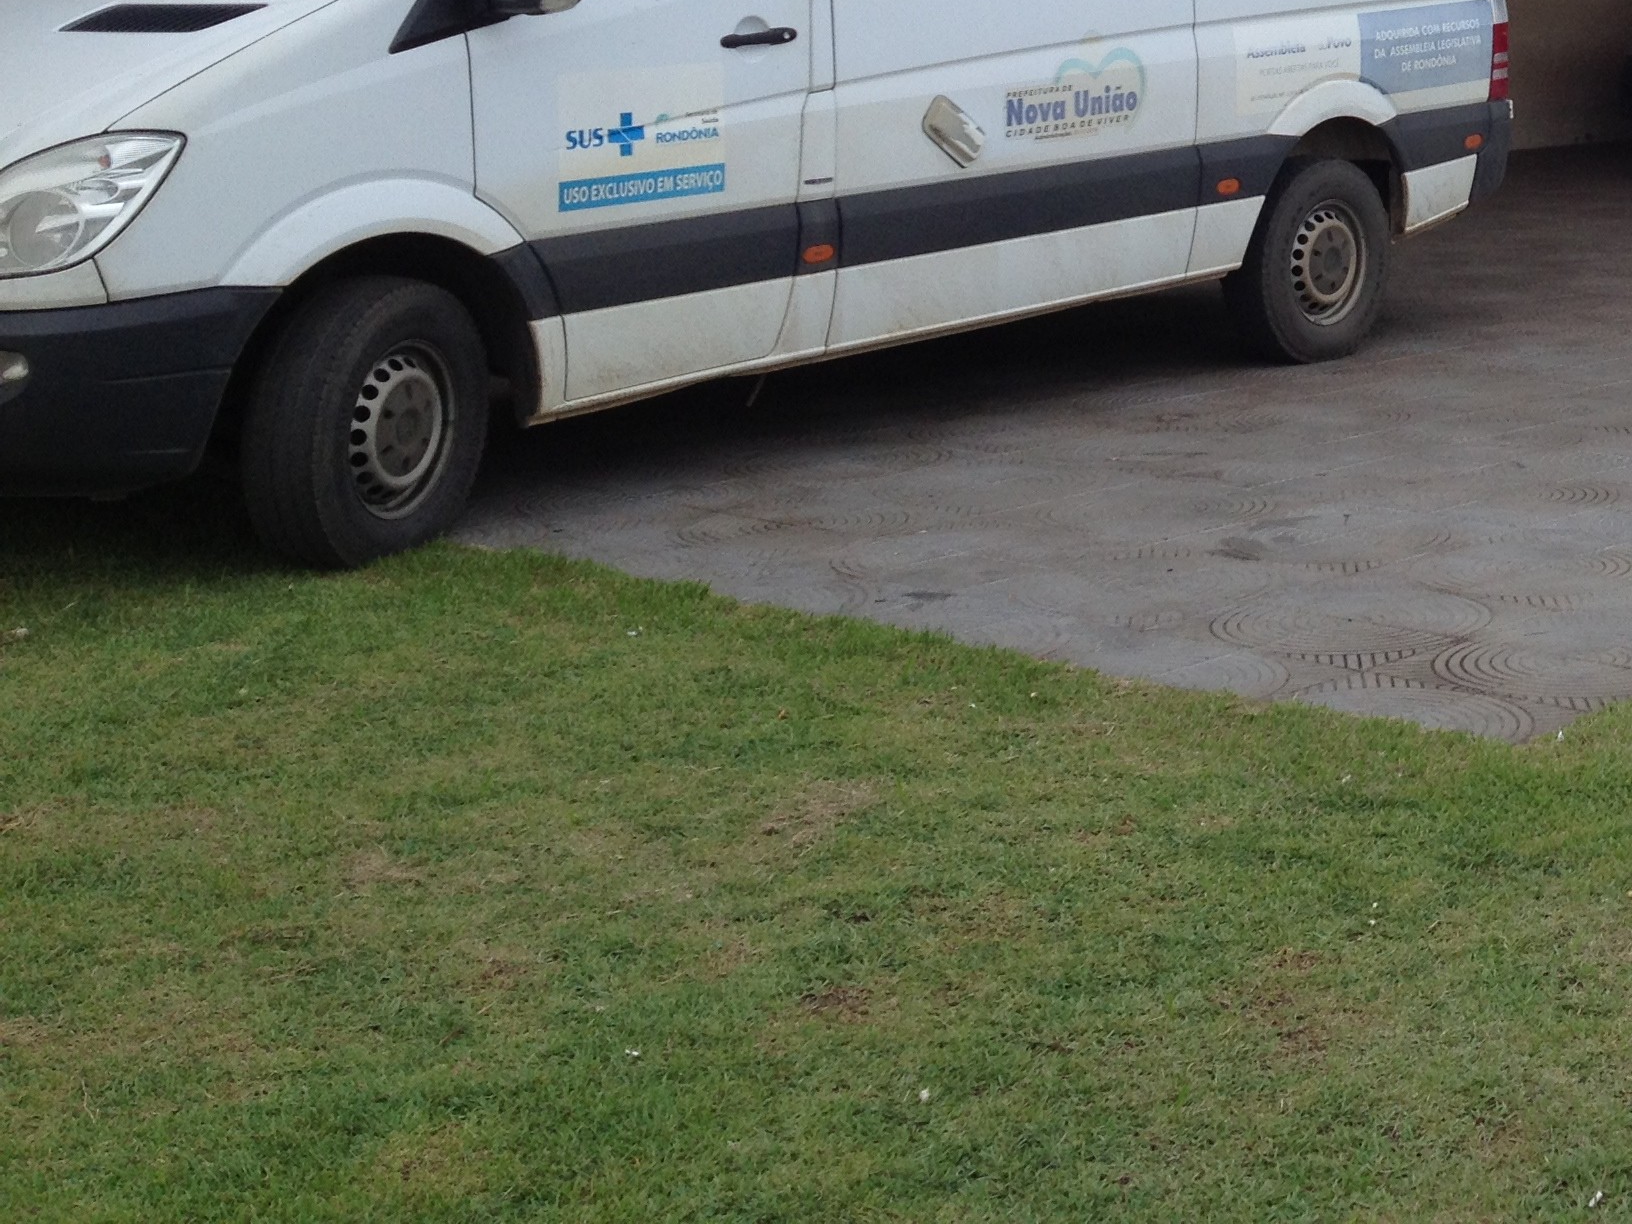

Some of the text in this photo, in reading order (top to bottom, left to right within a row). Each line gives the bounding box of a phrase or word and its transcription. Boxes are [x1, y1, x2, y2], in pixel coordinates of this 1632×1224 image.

[1376, 18, 1480, 41] ADQUIRIDA COM RECURSOS
[1374, 35, 1482, 59] DA ASSEMBLEIA LEGISLATIVA
[1401, 54, 1457, 72] DE RONDÔNIA
[1006, 84, 1073, 98] PREFEITURA DE
[1005, 85, 1137, 126] Nova União
[656, 126, 720, 144] RONDÔNIA
[1005, 125, 1049, 138] CIDADE
[1053, 122, 1076, 132] BOA
[1080, 119, 1093, 128] DE
[1097, 114, 1130, 125] VIVER
[565, 127, 604, 150] SUS
[563, 170, 723, 204] USO EXCLUSIVO EM SERVIÇO
